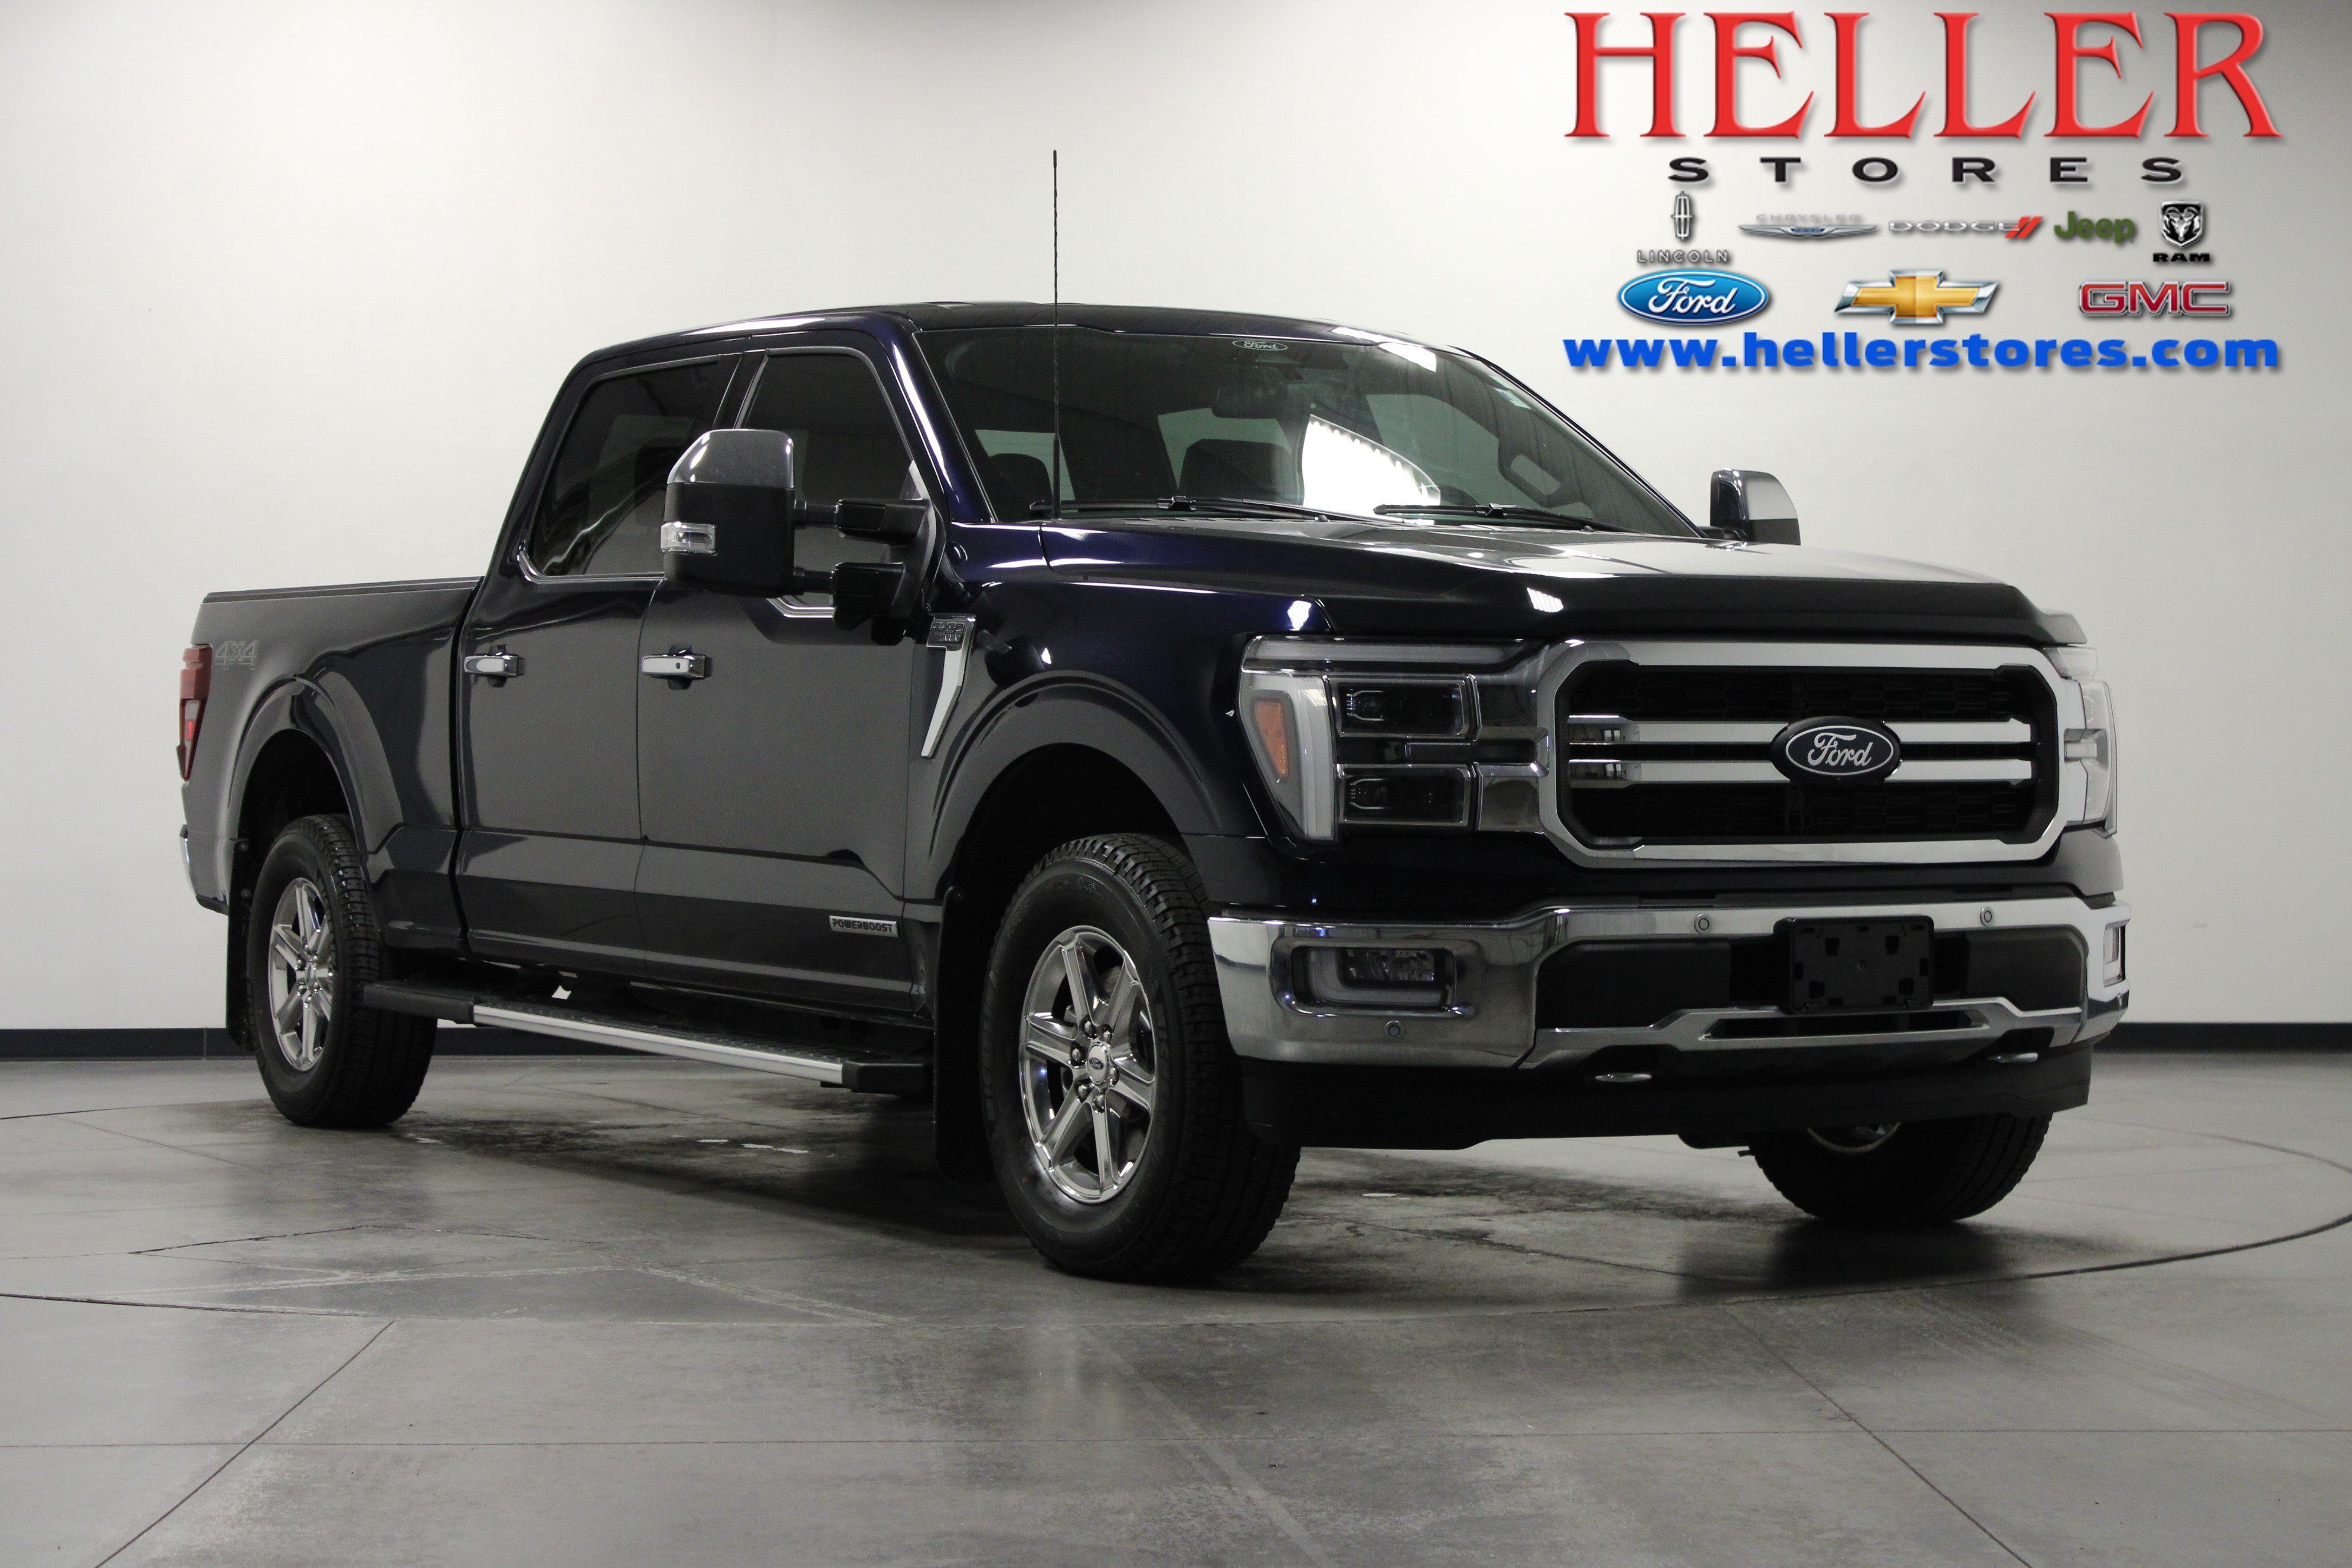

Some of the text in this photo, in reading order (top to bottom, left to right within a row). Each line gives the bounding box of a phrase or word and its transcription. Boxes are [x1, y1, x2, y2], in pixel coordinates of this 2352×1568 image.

[1244, 341, 1279, 349] Ford
[1807, 732, 1874, 766] Ford
[832, 919, 893, 933] POWERBOOST
